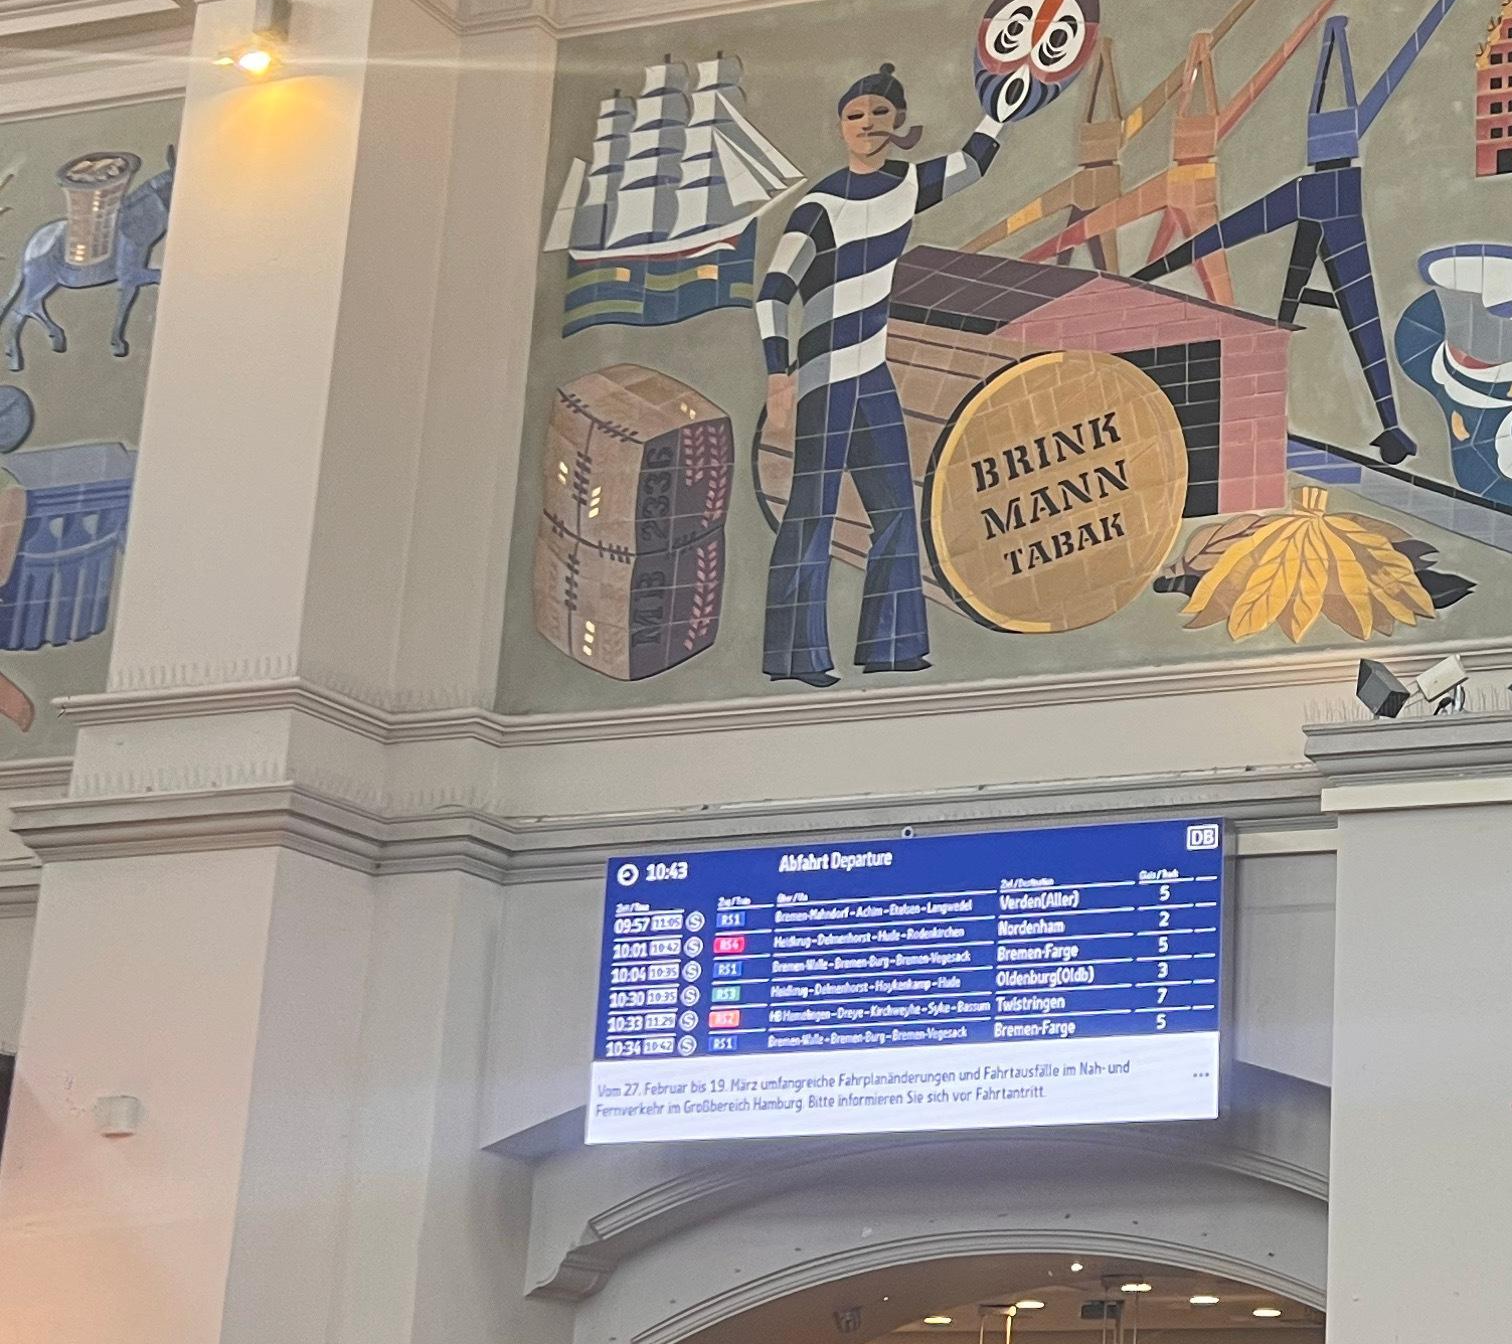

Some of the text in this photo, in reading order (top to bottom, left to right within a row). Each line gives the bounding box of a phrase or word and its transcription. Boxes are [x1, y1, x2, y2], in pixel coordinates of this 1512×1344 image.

[971, 411, 1122, 493] BRINK
[980, 459, 1130, 541] MANN
[1003, 512, 1126, 576] TABAK
[644, 826, 1217, 881] 10:43 Abfahrt Departure DB
[998, 889, 1080, 911] Verden(Aller)
[1158, 884, 1171, 901] 5
[611, 942, 649, 959] 10:01
[997, 916, 1065, 937] Nordenham
[1158, 910, 1170, 927] 2
[996, 941, 1079, 965] Bremen-Farge
[1157, 935, 1169, 953] 5
[995, 964, 1095, 990] Oldenburg(Oldb)
[1156, 961, 1169, 978] 3
[995, 992, 1066, 1015] Twistringen
[1155, 987, 1168, 1004] 7
[993, 1017, 1076, 1041] Bremen-Farge
[1155, 1013, 1167, 1030] 5
[597, 1085, 622, 1097] Vom
[644, 1080, 688, 1095] Februar
[690, 1080, 707, 1093] bis
[730, 1077, 758, 1092] März
[760, 1073, 835, 1094] umfangreiche
[838, 1067, 956, 1090] Fahrplanänderungen
[958, 1066, 980, 1081] und
[983, 1062, 1060, 1080] Fahrtausfälle
[1062, 1062, 1077, 1076] im
[1079, 1060, 1106, 1075] Nah-
[1108, 1059, 1130, 1074] und
[595, 1101, 664, 1117] Fernverkehr
[667, 1101, 681, 1114] im
[683, 1097, 750, 1113] Großbereich
[808, 1094, 835, 1108] Bitte
[837, 1091, 904, 1107] informieren
[906, 1090, 924, 1104] Sie
[926, 1089, 949, 1103] sich
[952, 1091, 971, 1102] vor
